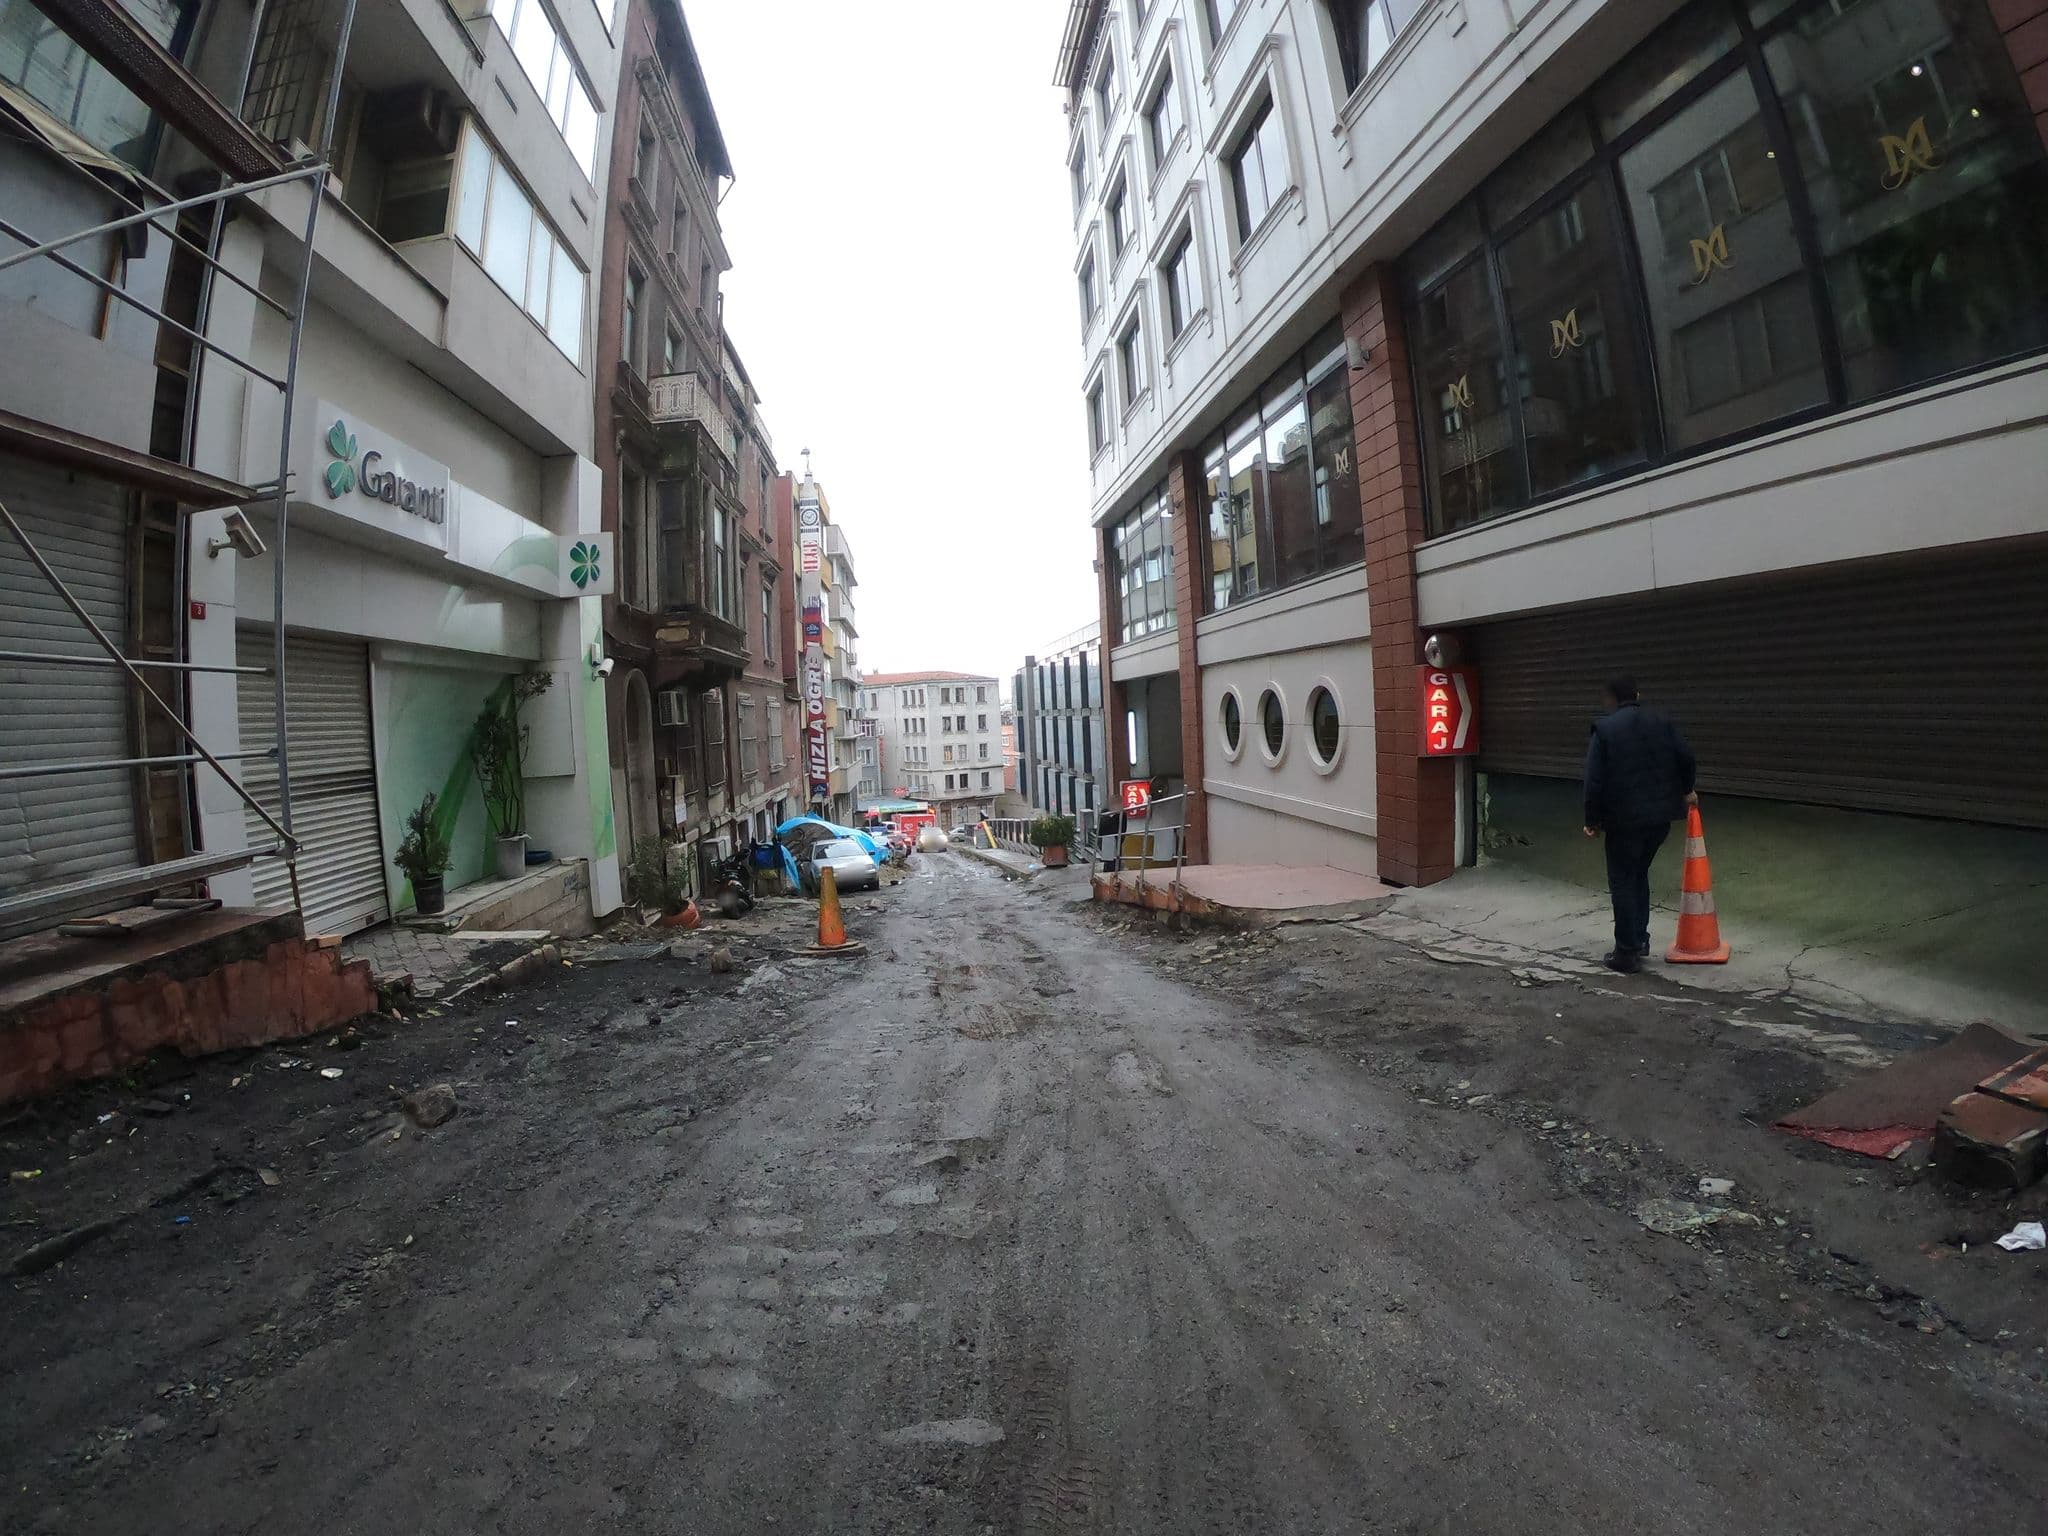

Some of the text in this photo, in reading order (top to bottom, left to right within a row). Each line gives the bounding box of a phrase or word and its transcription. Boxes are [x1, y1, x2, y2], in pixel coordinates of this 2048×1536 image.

[360, 450, 445, 525] Garanti
[1430, 672, 1449, 750] GARAJ
[810, 718, 826, 780] HIZLA
